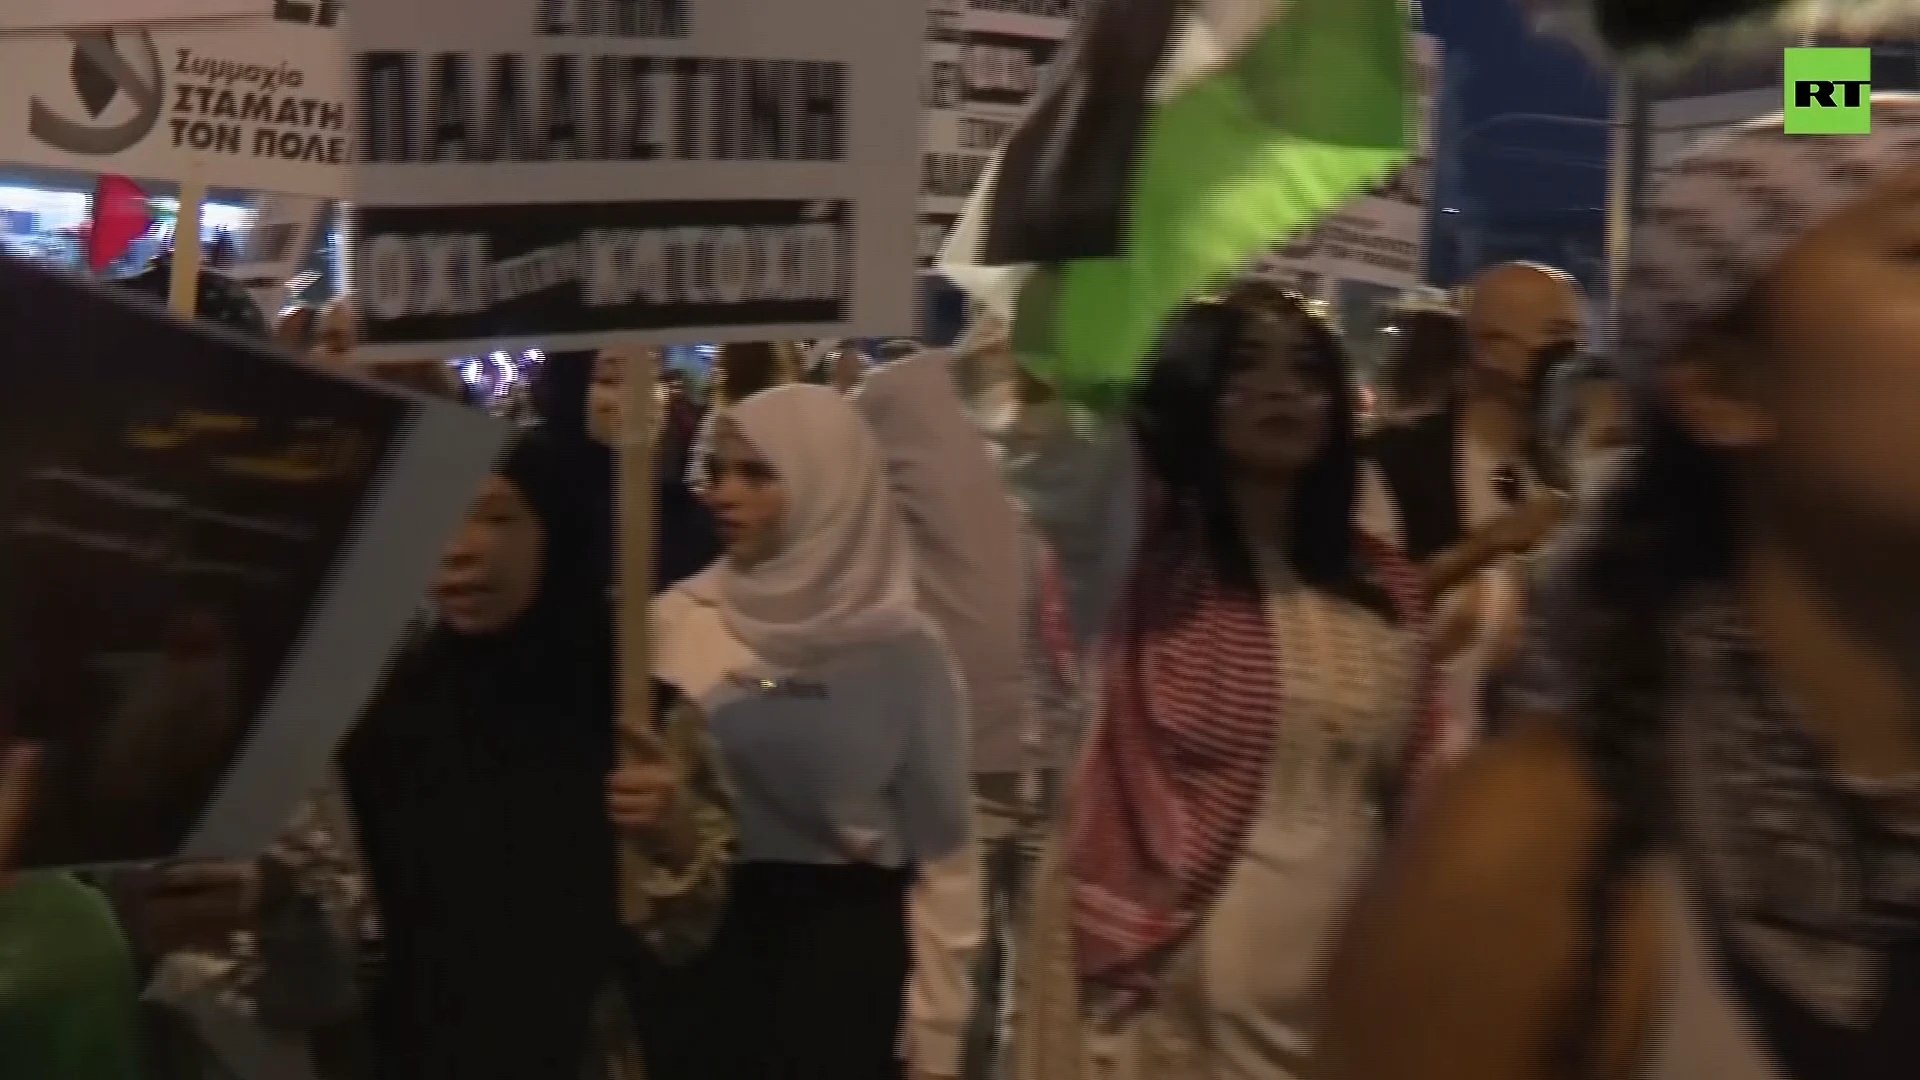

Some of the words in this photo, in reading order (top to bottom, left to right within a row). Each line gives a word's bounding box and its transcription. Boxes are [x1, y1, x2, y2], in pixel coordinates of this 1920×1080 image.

[174, 48, 304, 92] Συμμαχία
[171, 83, 346, 131] ΣΤΑΜΑΤΗ
[357, 51, 852, 162] ΠΑΛΑΙΣΤΙΝΗ
[168, 117, 243, 154] ΤΟΝ
[252, 127, 349, 165] ΠΟΛΕ
[358, 230, 492, 321] ΟΧΙ
